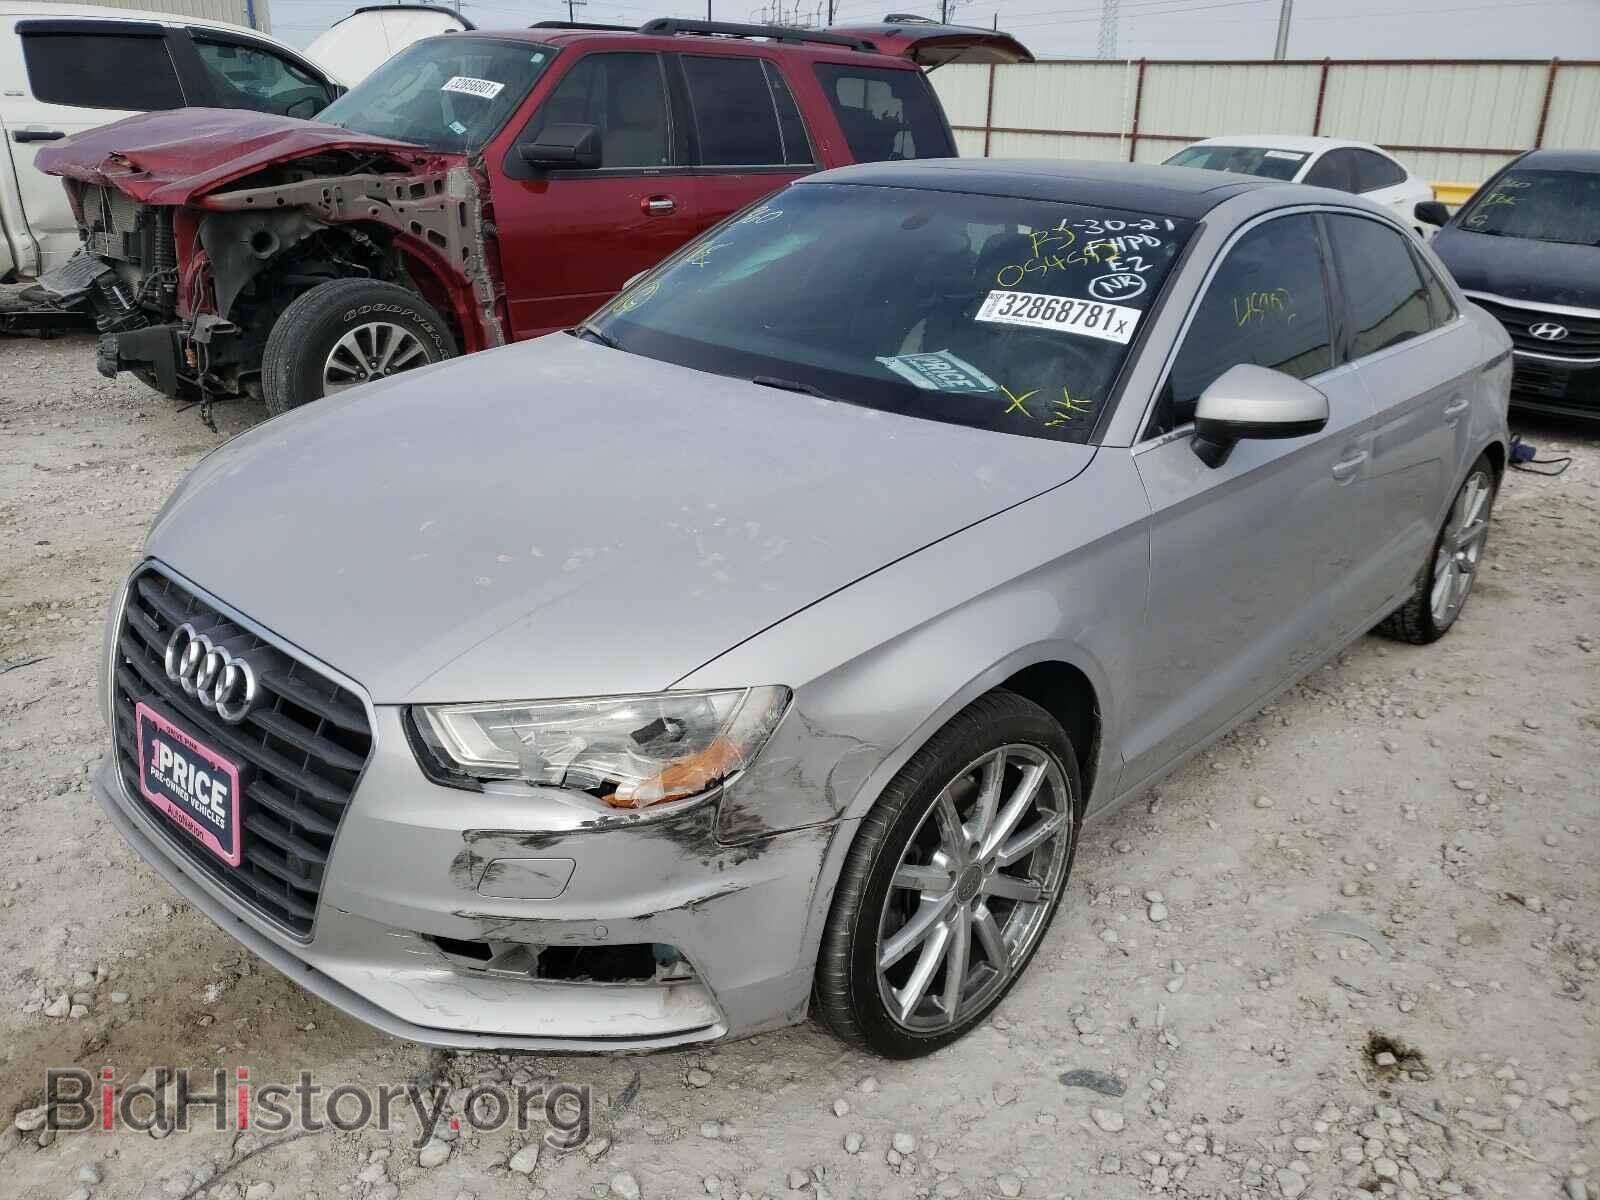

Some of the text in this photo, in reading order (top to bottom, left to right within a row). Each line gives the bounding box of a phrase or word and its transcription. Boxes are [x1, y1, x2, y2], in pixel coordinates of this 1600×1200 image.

[998, 293, 1116, 331] 32868781
[150, 767, 225, 830] PRE-OWNED VEHICLES
[167, 805, 205, 840] AutoNation
